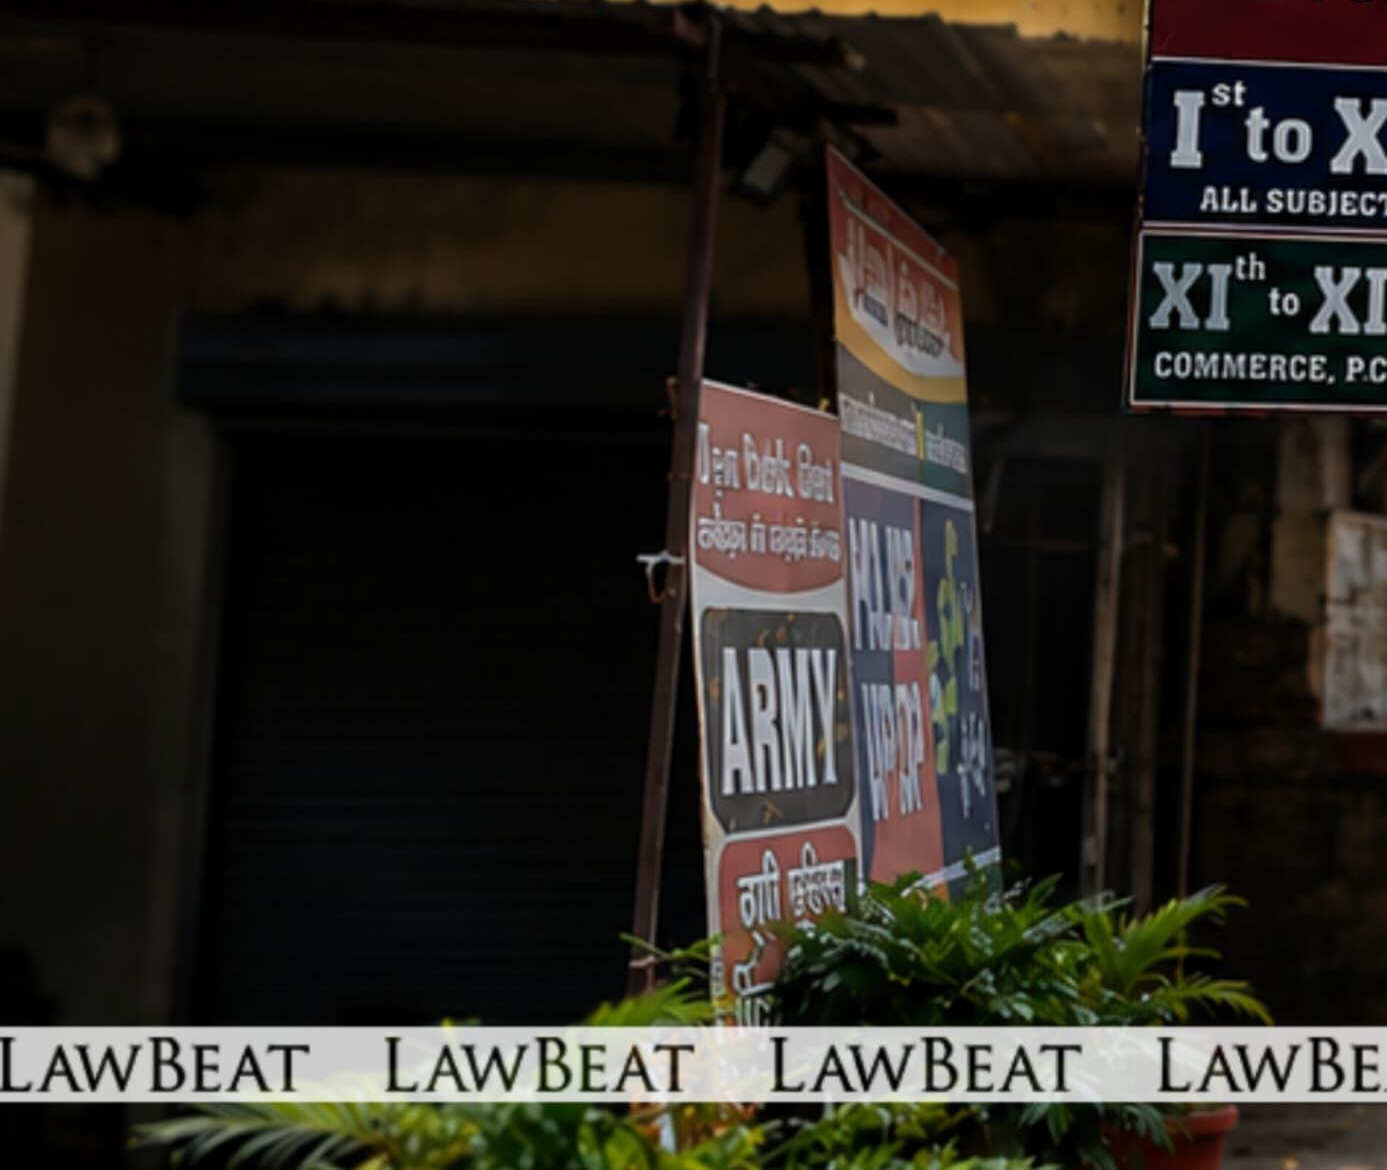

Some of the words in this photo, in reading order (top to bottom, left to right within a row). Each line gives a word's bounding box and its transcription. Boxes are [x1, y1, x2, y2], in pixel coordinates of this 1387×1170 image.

[1245, 106, 1313, 164] to
[1200, 186, 1257, 213] ALL
[1268, 287, 1300, 316] to
[1154, 351, 1335, 385] COMMERCE,
[722, 647, 838, 796] ARMY
